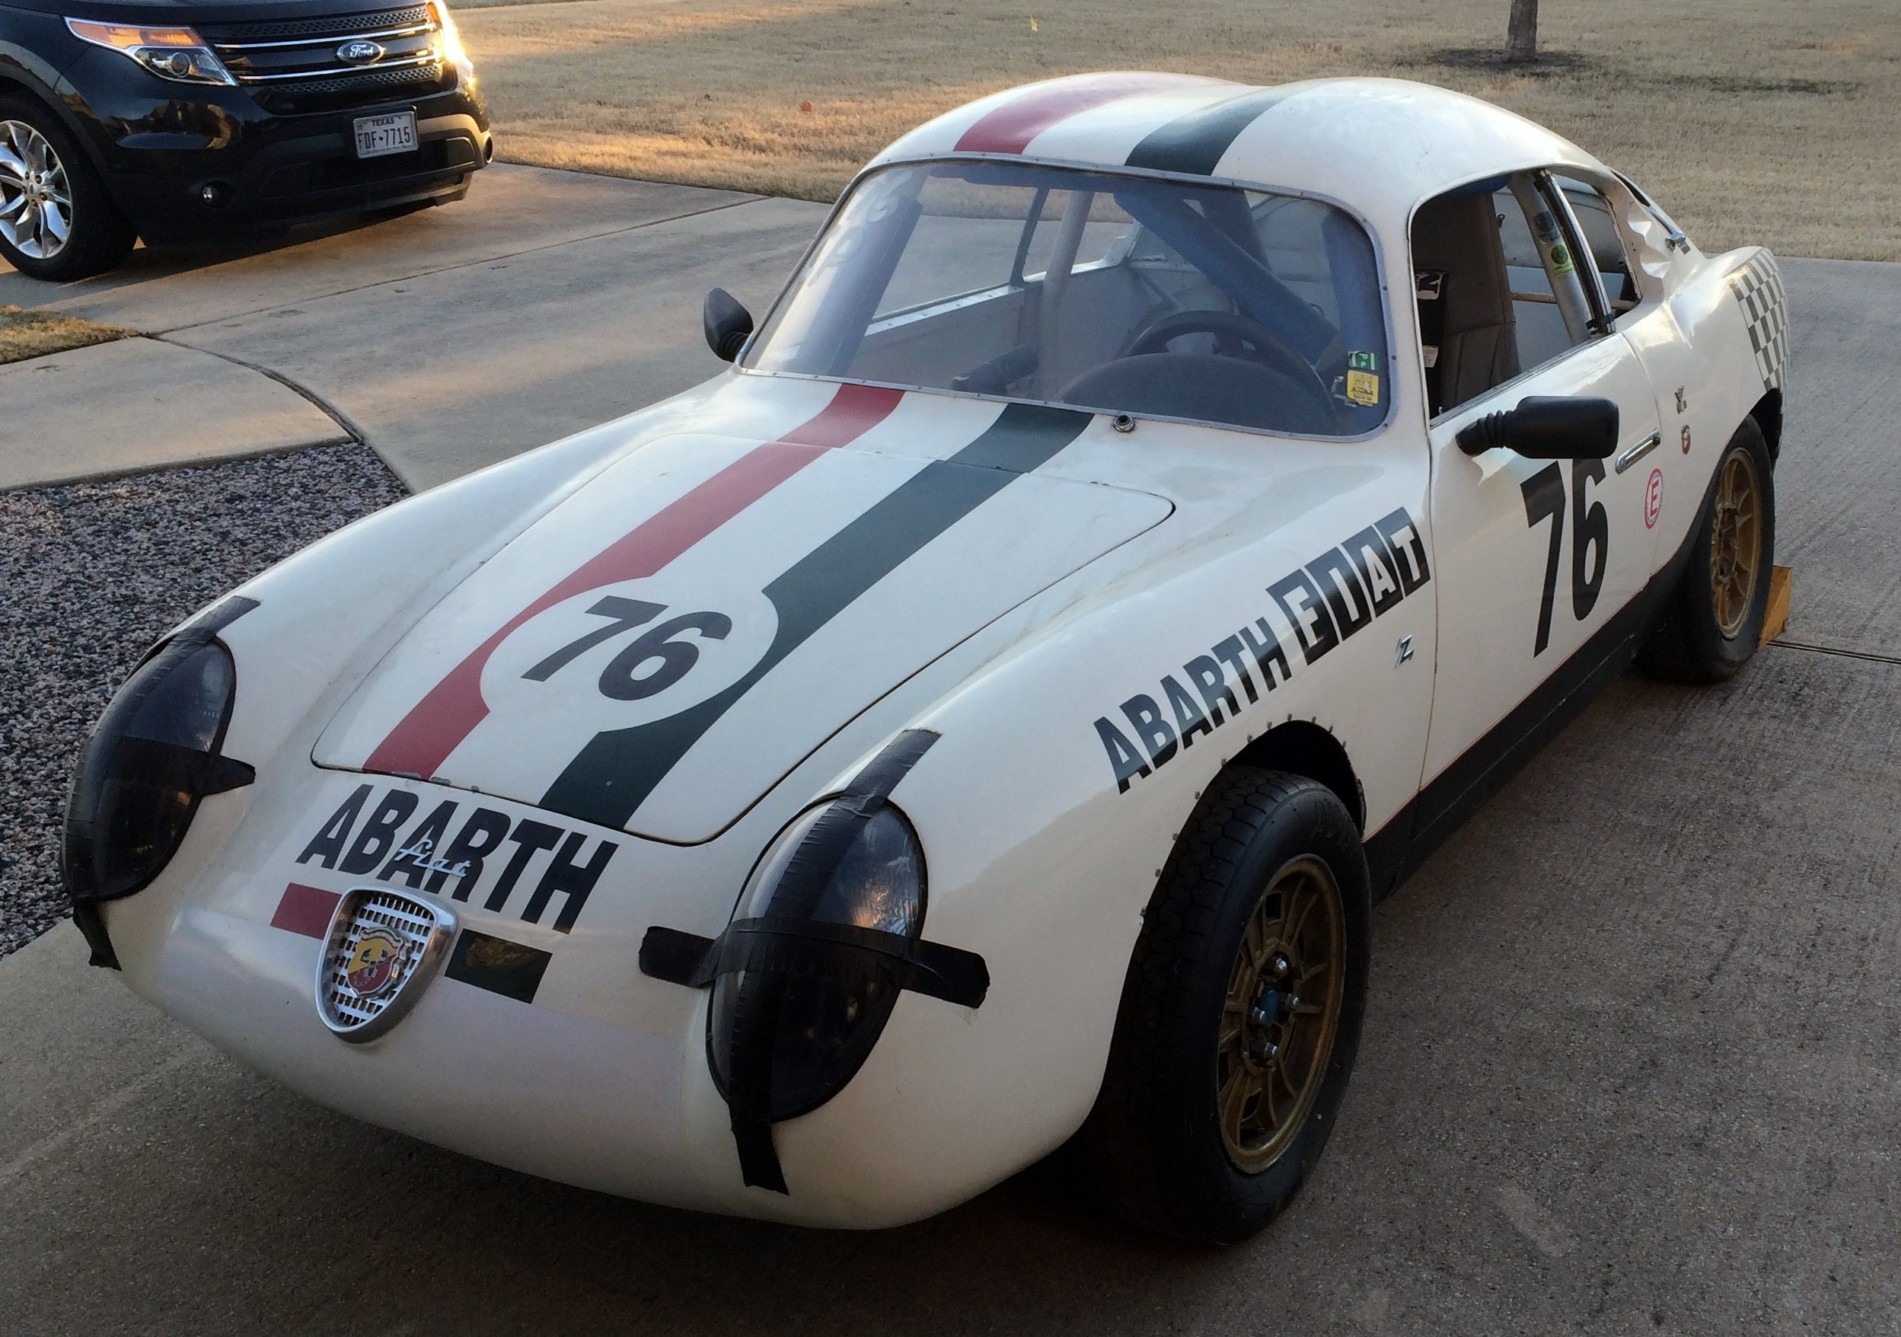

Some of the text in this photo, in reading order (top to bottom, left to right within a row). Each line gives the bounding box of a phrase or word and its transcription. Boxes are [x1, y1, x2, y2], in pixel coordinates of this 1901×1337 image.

[350, 44, 374, 58] Ford
[372, 117, 395, 127] TEXAS
[1520, 458, 1609, 658] 76
[520, 595, 733, 701] 76
[1094, 506, 1431, 794] ABARTH FIAT
[295, 784, 619, 935] ABARTH
